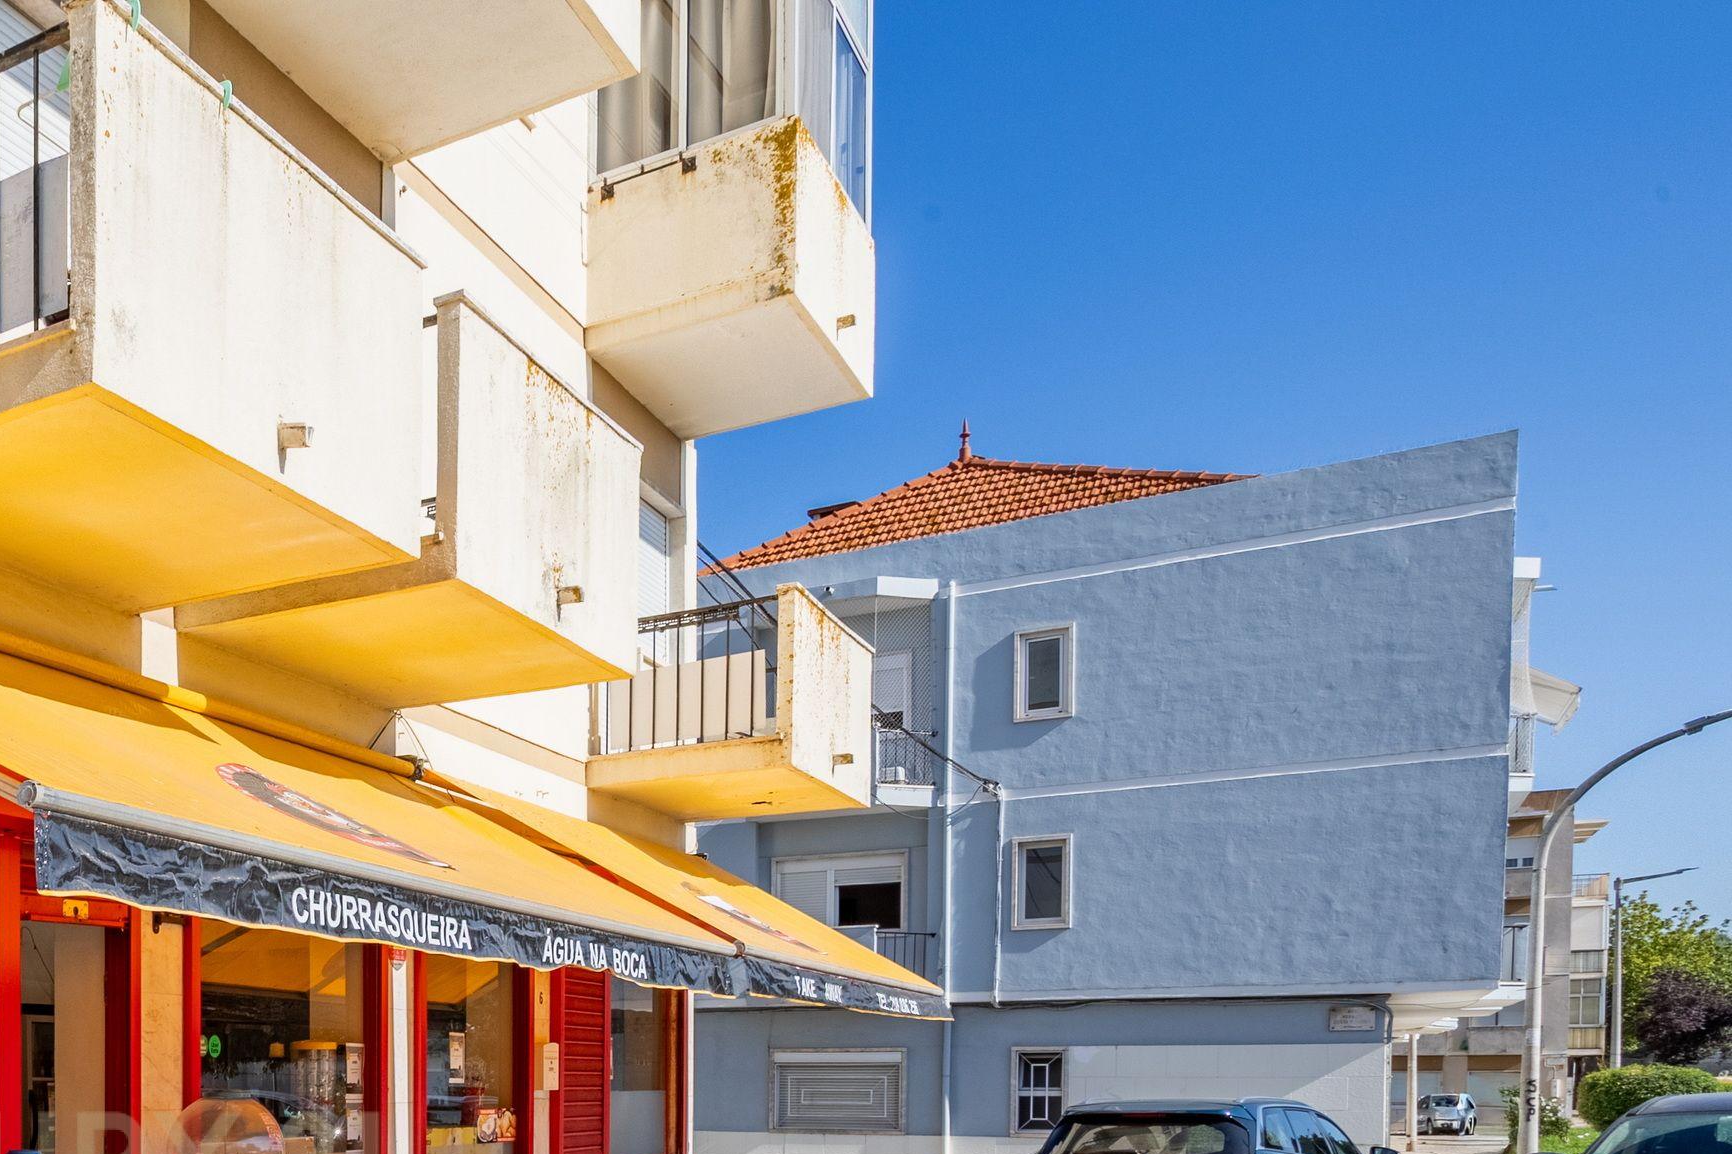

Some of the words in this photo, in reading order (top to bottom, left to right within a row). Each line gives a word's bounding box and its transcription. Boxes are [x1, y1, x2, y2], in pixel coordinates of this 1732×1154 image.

[291, 887, 473, 950] CHURRASQUEIRA
[542, 928, 586, 967] ÁGUA
[589, 943, 608, 969] NA
[612, 948, 648, 980] BOCA
[538, 991, 544, 1005] 6
[794, 975, 818, 998] TAKE
